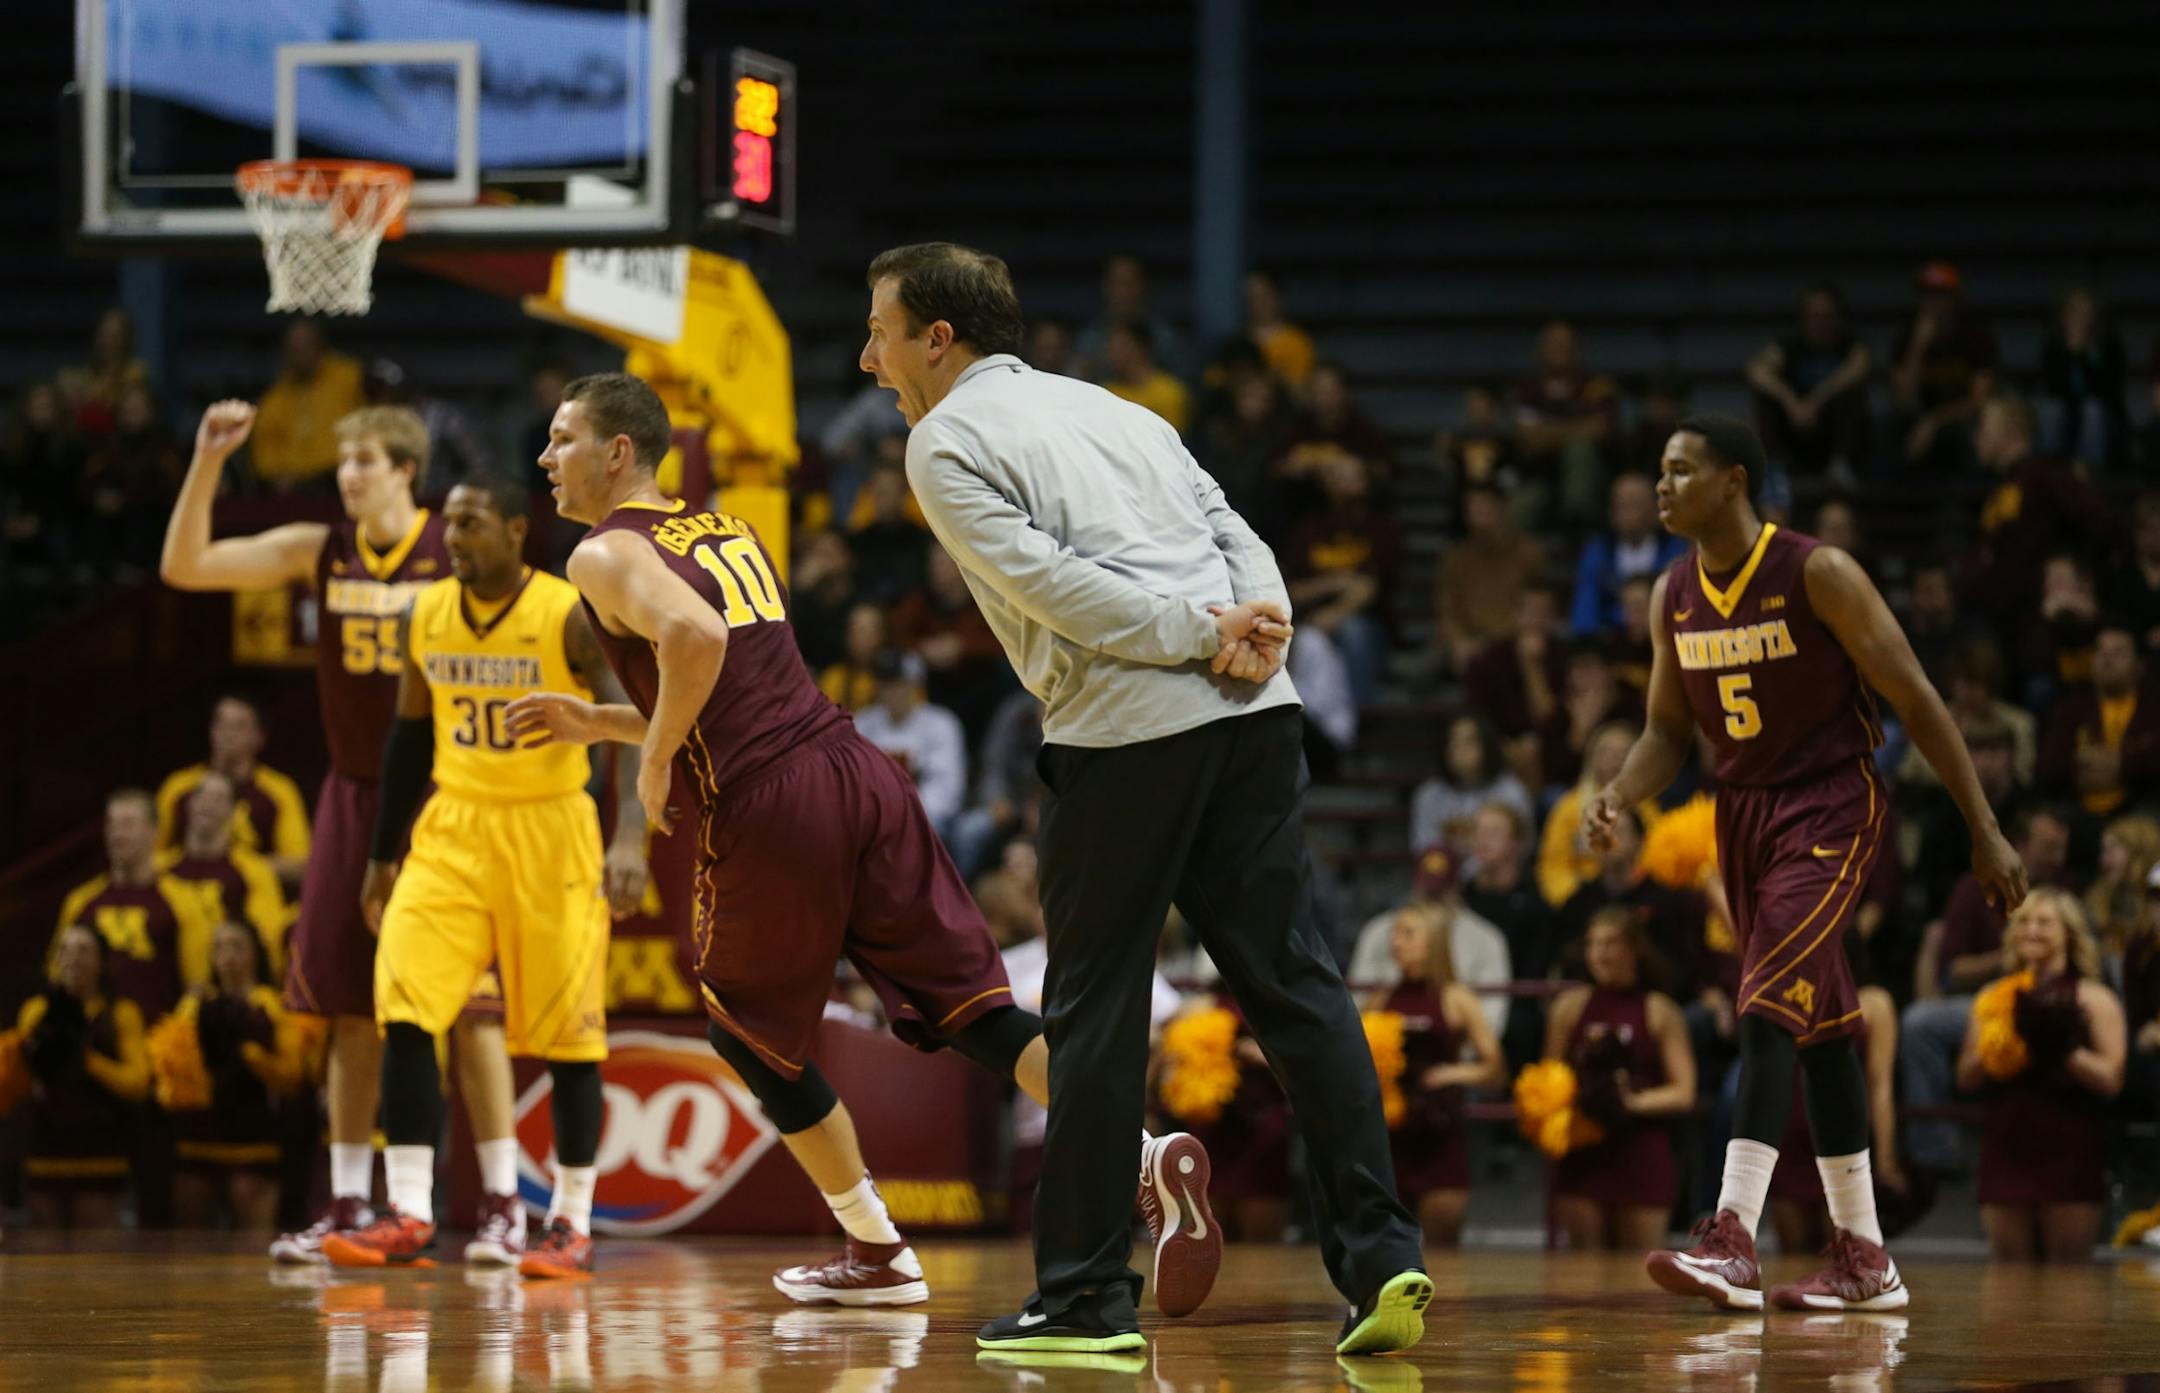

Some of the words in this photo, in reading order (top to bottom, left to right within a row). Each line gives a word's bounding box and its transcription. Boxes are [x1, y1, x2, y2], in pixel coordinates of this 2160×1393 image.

[693, 536, 785, 629] 10
[424, 652, 544, 689] MINNESOTA
[1674, 618, 1797, 670] MINNESOTA
[1717, 672, 1762, 741] 5
